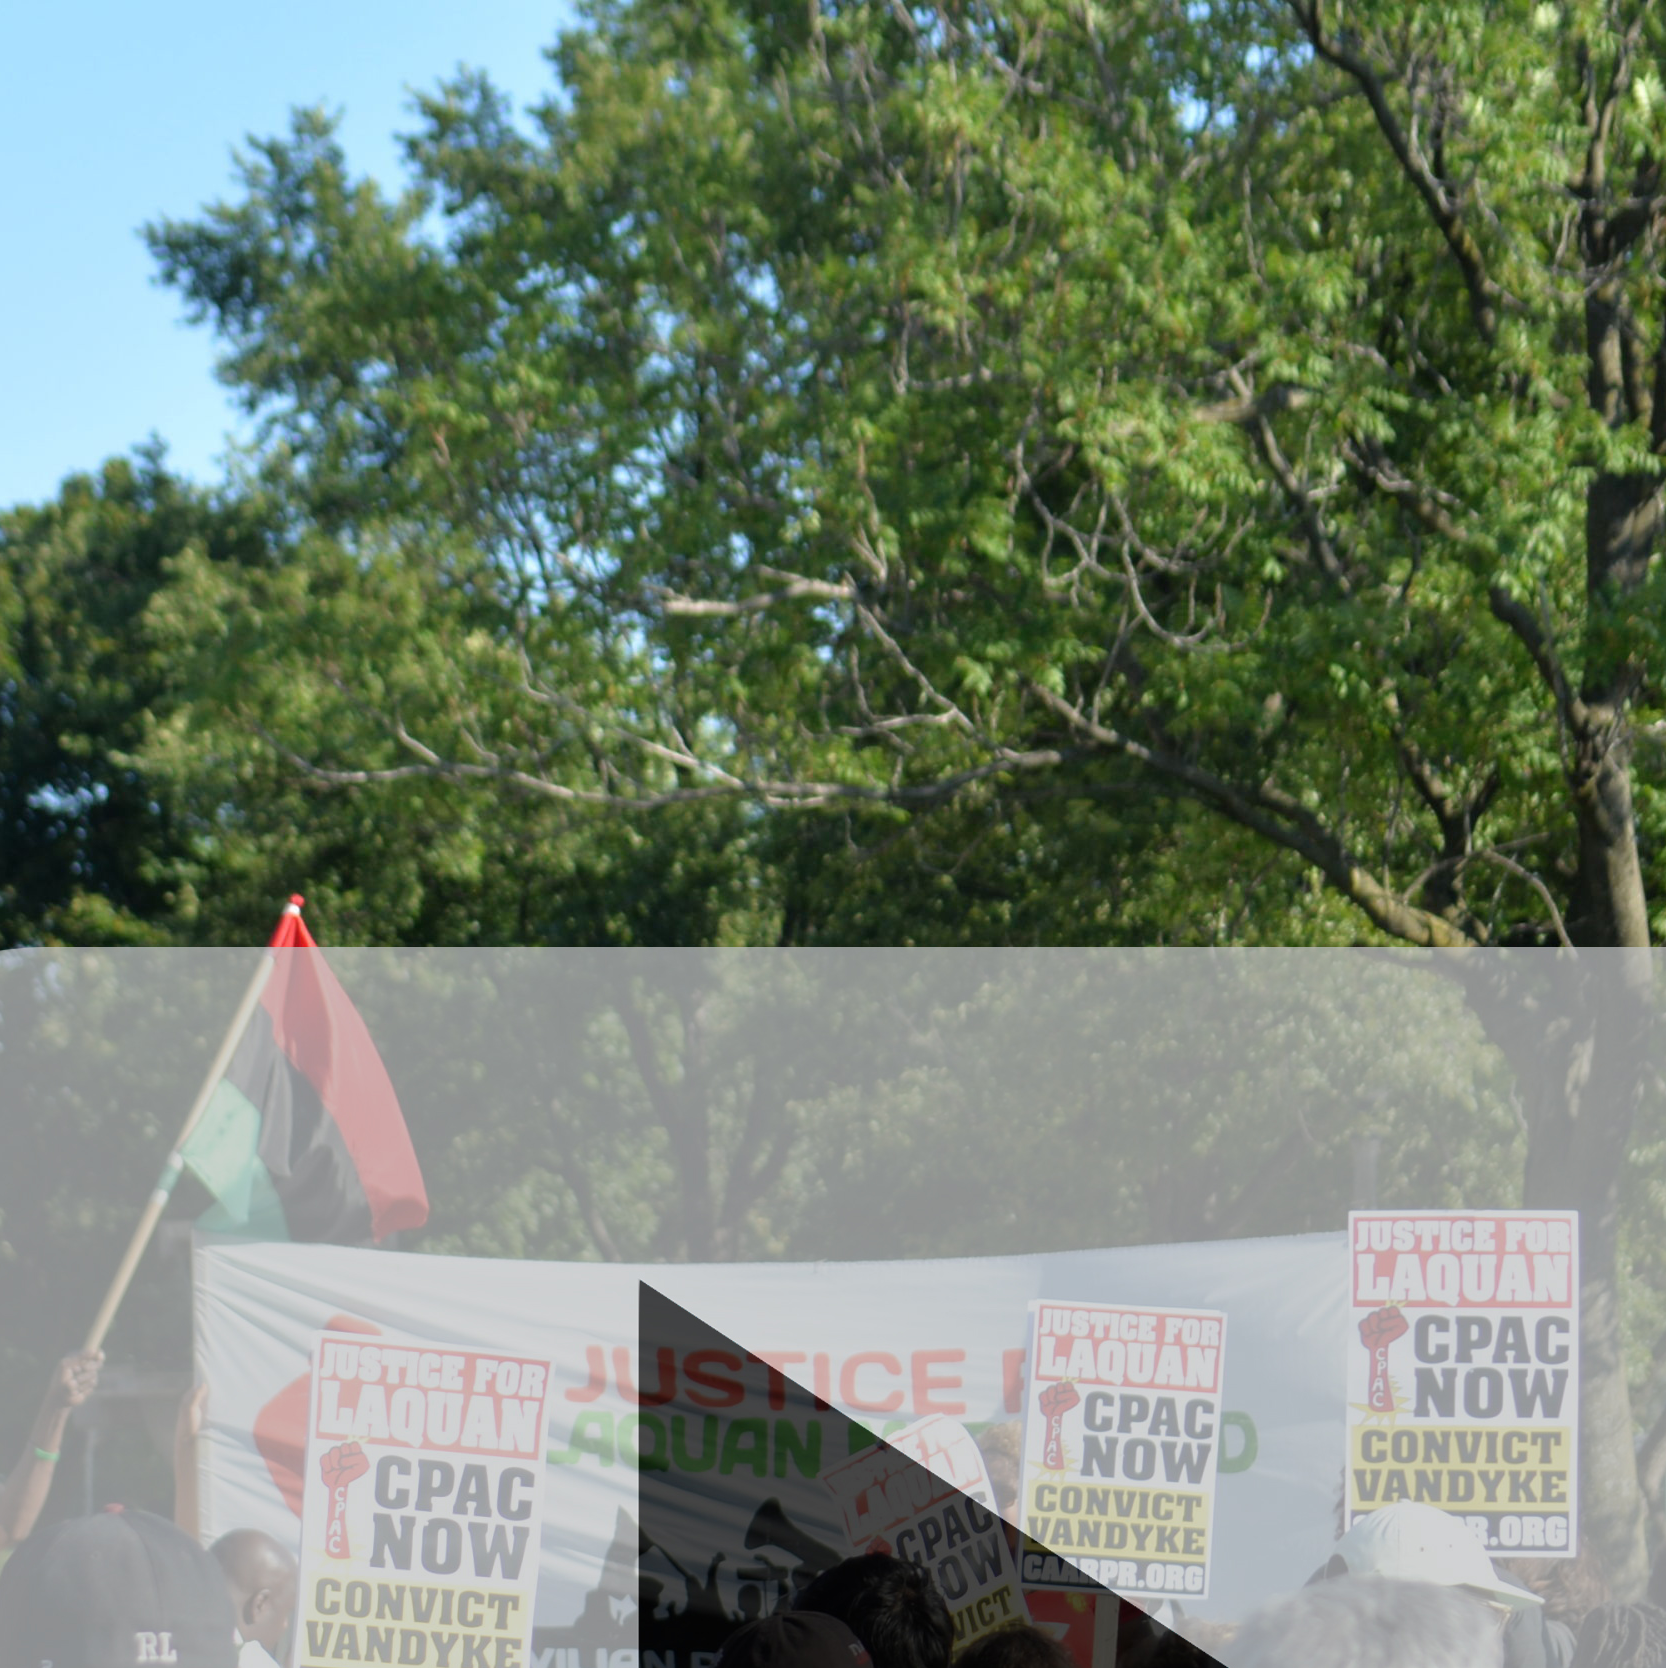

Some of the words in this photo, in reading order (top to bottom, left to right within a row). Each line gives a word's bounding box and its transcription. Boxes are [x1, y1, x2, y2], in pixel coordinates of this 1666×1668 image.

[1355, 1220, 1496, 1252] JUSTICE
[1505, 1220, 1571, 1253] FOR
[1356, 1253, 1569, 1306] LAQUAN
[1039, 1308, 1157, 1342] JUSTICE
[1164, 1316, 1220, 1347] FOR
[1414, 1315, 1569, 1364] CPAC
[319, 1342, 465, 1391] JUSTICE
[473, 1358, 546, 1398] FOR
[564, 1345, 967, 1415] JUSTICE
[1038, 1336, 1217, 1388] LAQUAN
[1372, 1348, 1387, 1407] CPAC
[319, 1379, 540, 1453] LAQUAN
[1084, 1391, 1215, 1440] CPAC
[1413, 1367, 1568, 1419] NOW
[1046, 1416, 1061, 1465] CPAC
[1080, 1434, 1212, 1484] NOW
[1361, 1430, 1562, 1464] CONVICT
[374, 1455, 535, 1521] CPAC
[1035, 1484, 1202, 1522] CONVICT
[1353, 1468, 1567, 1502] VANDYKE
[329, 1487, 346, 1554] CPAC
[369, 1512, 530, 1580] NOW
[896, 1491, 994, 1565] CPAC
[1027, 1515, 1205, 1556] VANDYKE
[937, 1532, 1003, 1600] OW
[1023, 1554, 1204, 1592] CAARPR.ORG
[315, 1578, 520, 1630] CONVICT
[953, 1585, 1012, 1643] VICT
[135, 1631, 178, 1663] RL
